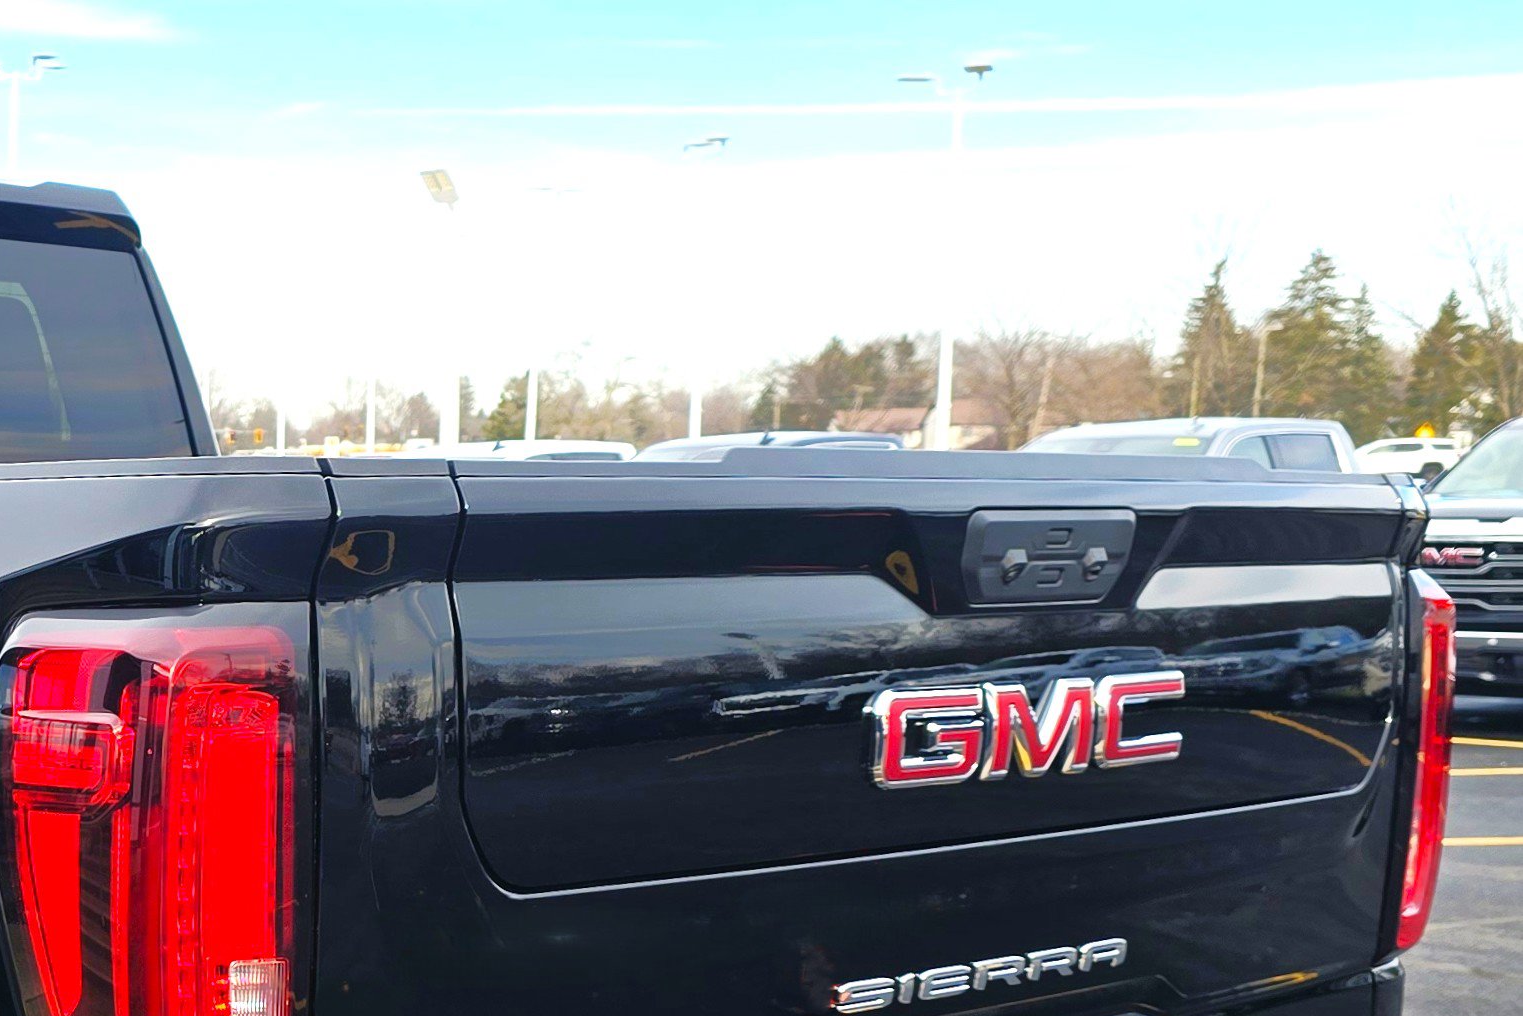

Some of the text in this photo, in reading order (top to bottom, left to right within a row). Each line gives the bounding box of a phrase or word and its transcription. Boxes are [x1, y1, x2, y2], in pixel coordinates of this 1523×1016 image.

[1419, 546, 1485, 566] MC
[864, 670, 1186, 790] GMC
[828, 937, 1128, 1014] SIERRA
